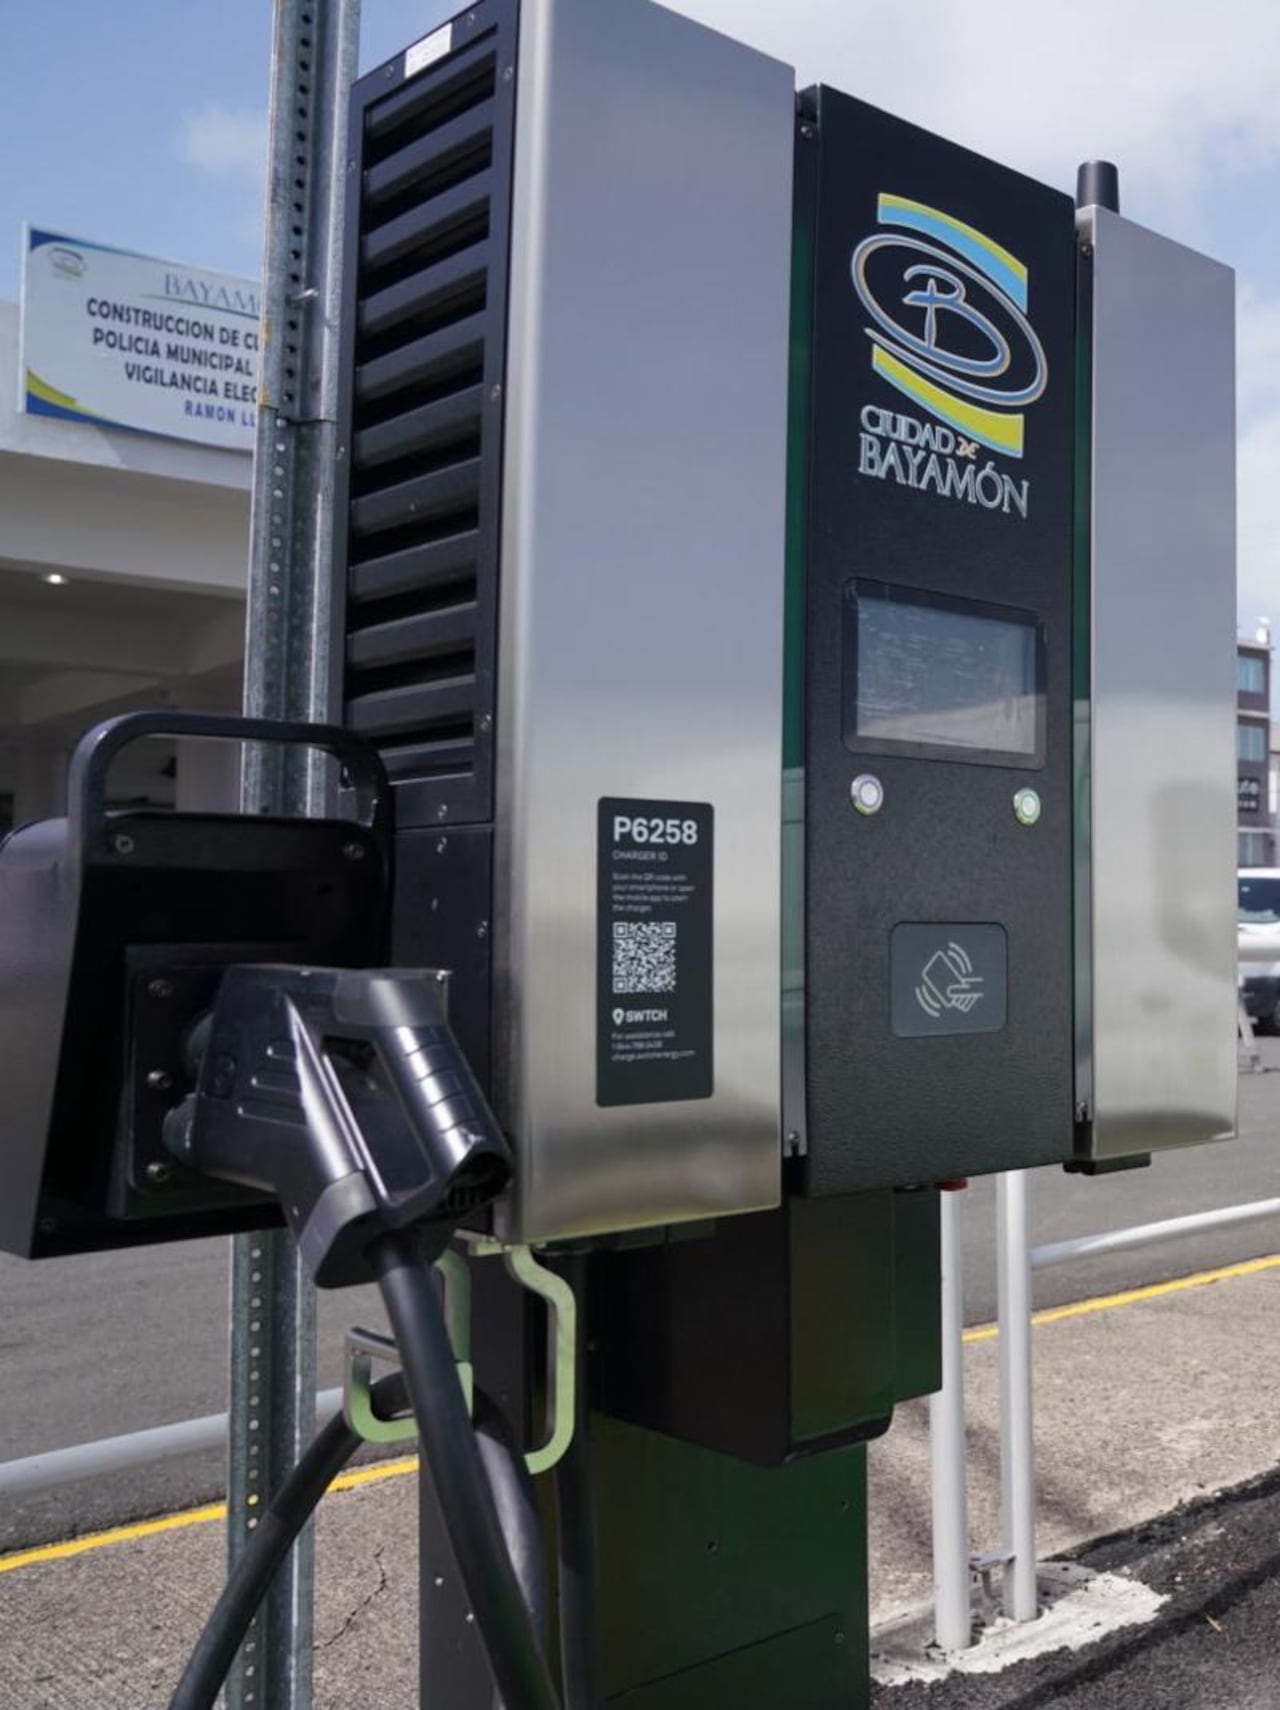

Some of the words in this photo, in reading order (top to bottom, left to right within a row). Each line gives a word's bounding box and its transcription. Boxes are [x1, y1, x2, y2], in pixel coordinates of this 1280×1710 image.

[164, 273, 260, 313] BAYAM
[86, 298, 214, 342] CONSTRUCCION
[219, 326, 240, 347] DE
[93, 327, 160, 359] POLICIA
[166, 344, 254, 377] MUNICIPAL
[125, 362, 219, 397] VIGILANCIA
[184, 400, 235, 425] RAMON
[860, 404, 956, 456] CIUDAD
[858, 432, 1031, 518] BAYAMÓN
[613, 815, 699, 845] P6258
[612, 849, 656, 860] CHARGER
[658, 850, 669, 861] ID
[626, 1009, 668, 1023] SWTCH
